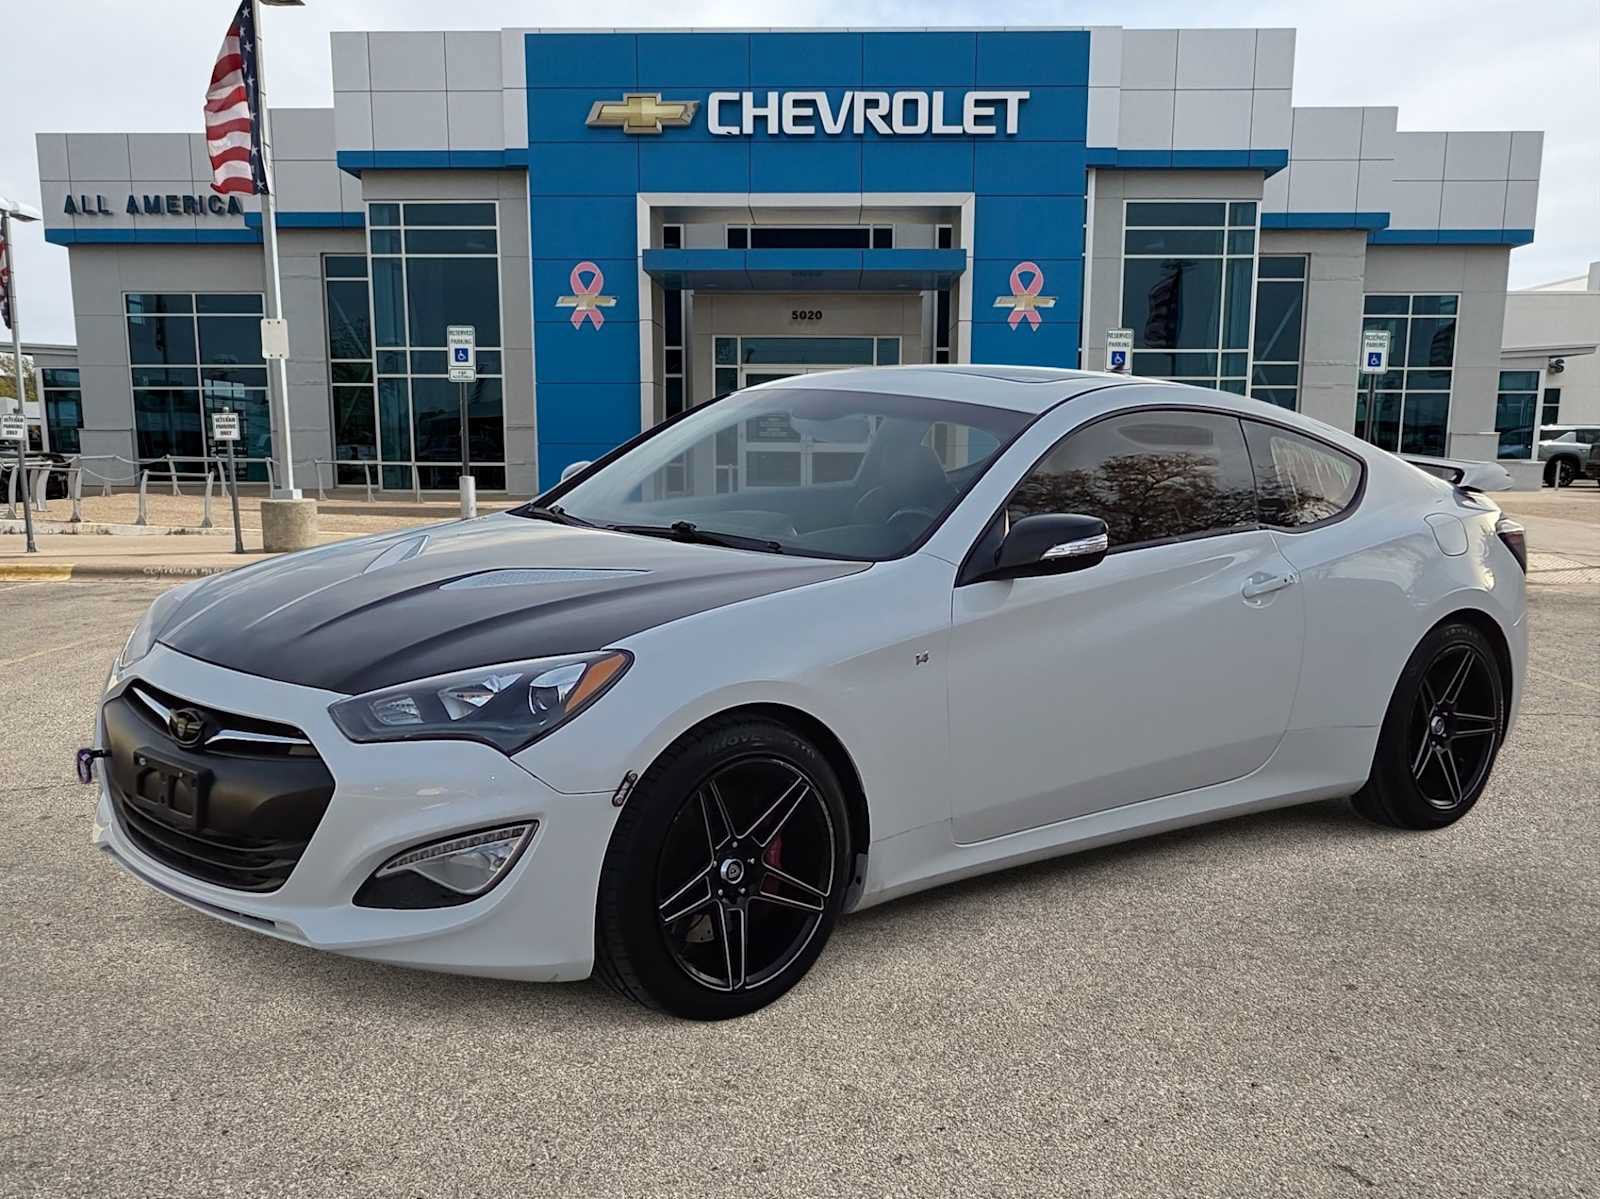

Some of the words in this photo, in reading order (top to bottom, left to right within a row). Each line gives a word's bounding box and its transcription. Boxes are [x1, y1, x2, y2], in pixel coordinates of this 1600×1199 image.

[707, 90, 1030, 136] CHEVROLET
[64, 194, 113, 216] ALL
[126, 194, 243, 216] AMERICA
[791, 310, 823, 320] 5020
